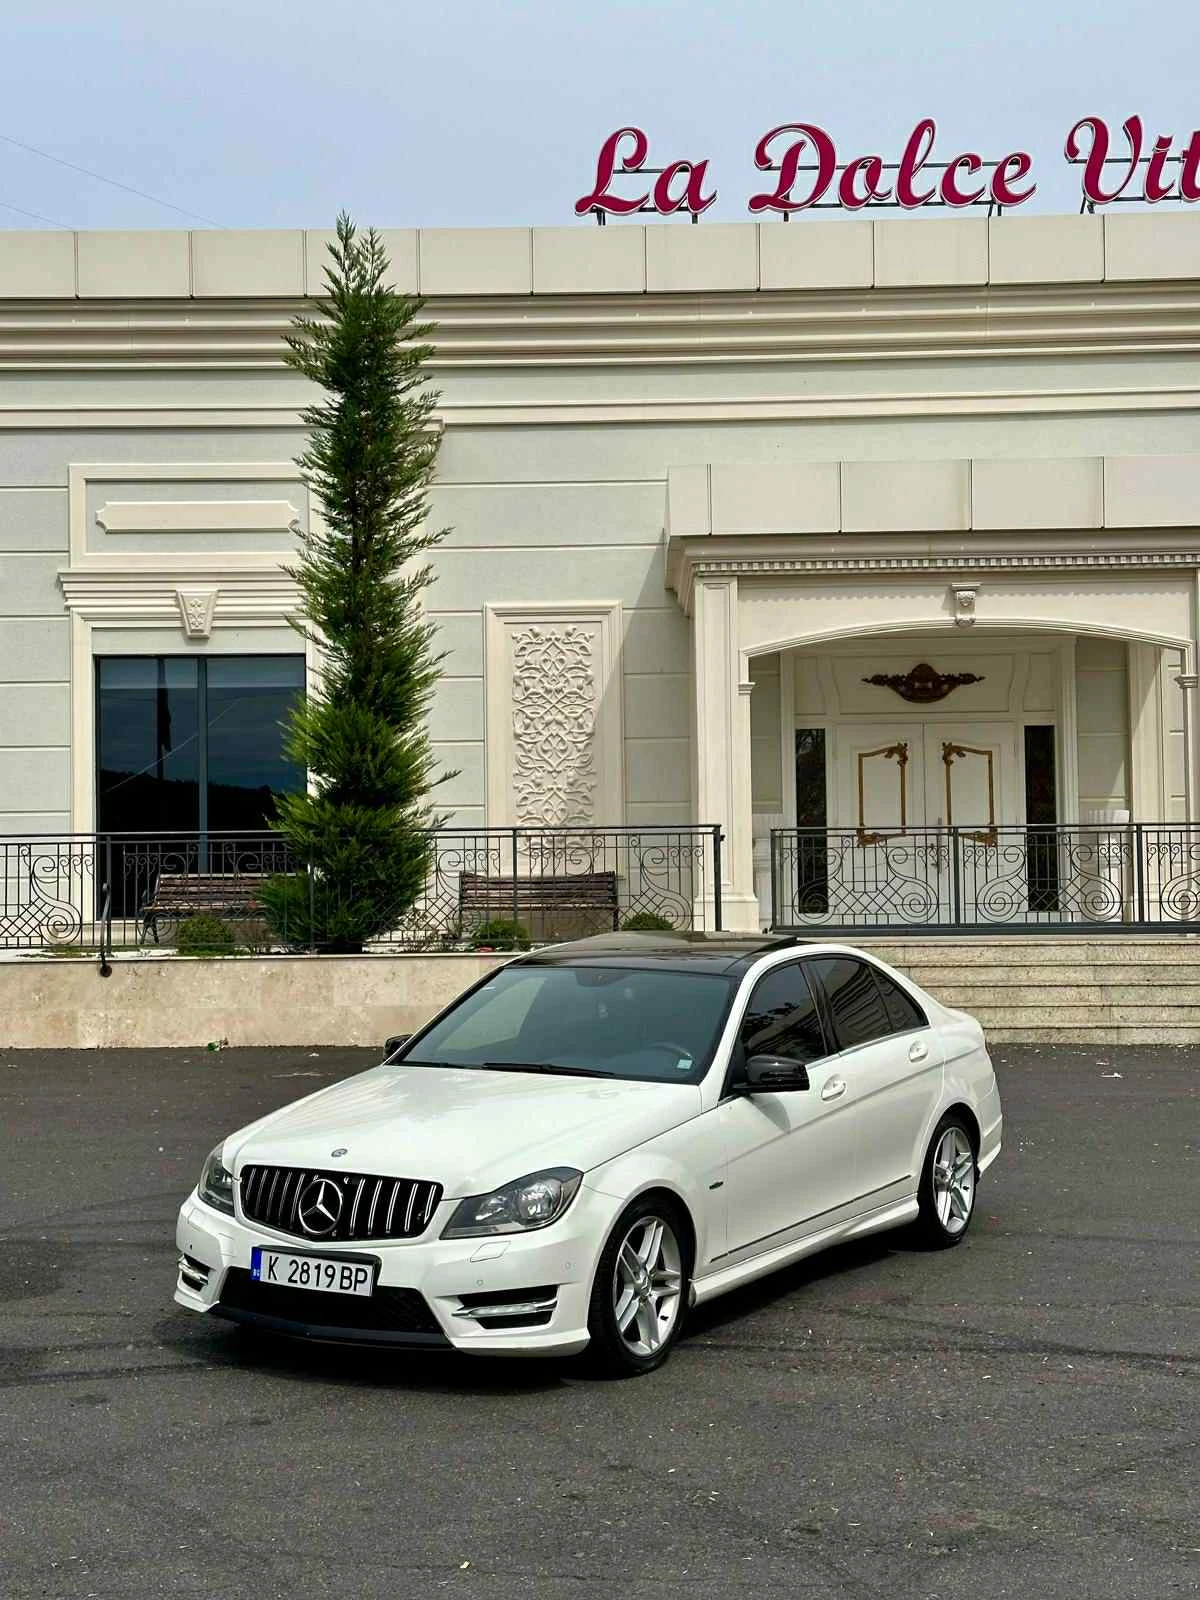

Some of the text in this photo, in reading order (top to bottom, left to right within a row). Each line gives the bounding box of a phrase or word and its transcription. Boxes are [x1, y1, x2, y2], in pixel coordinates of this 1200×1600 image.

[575, 126, 717, 215] La
[748, 119, 1036, 212] Dolce
[267, 1256, 368, 1292] K 2819 BP
